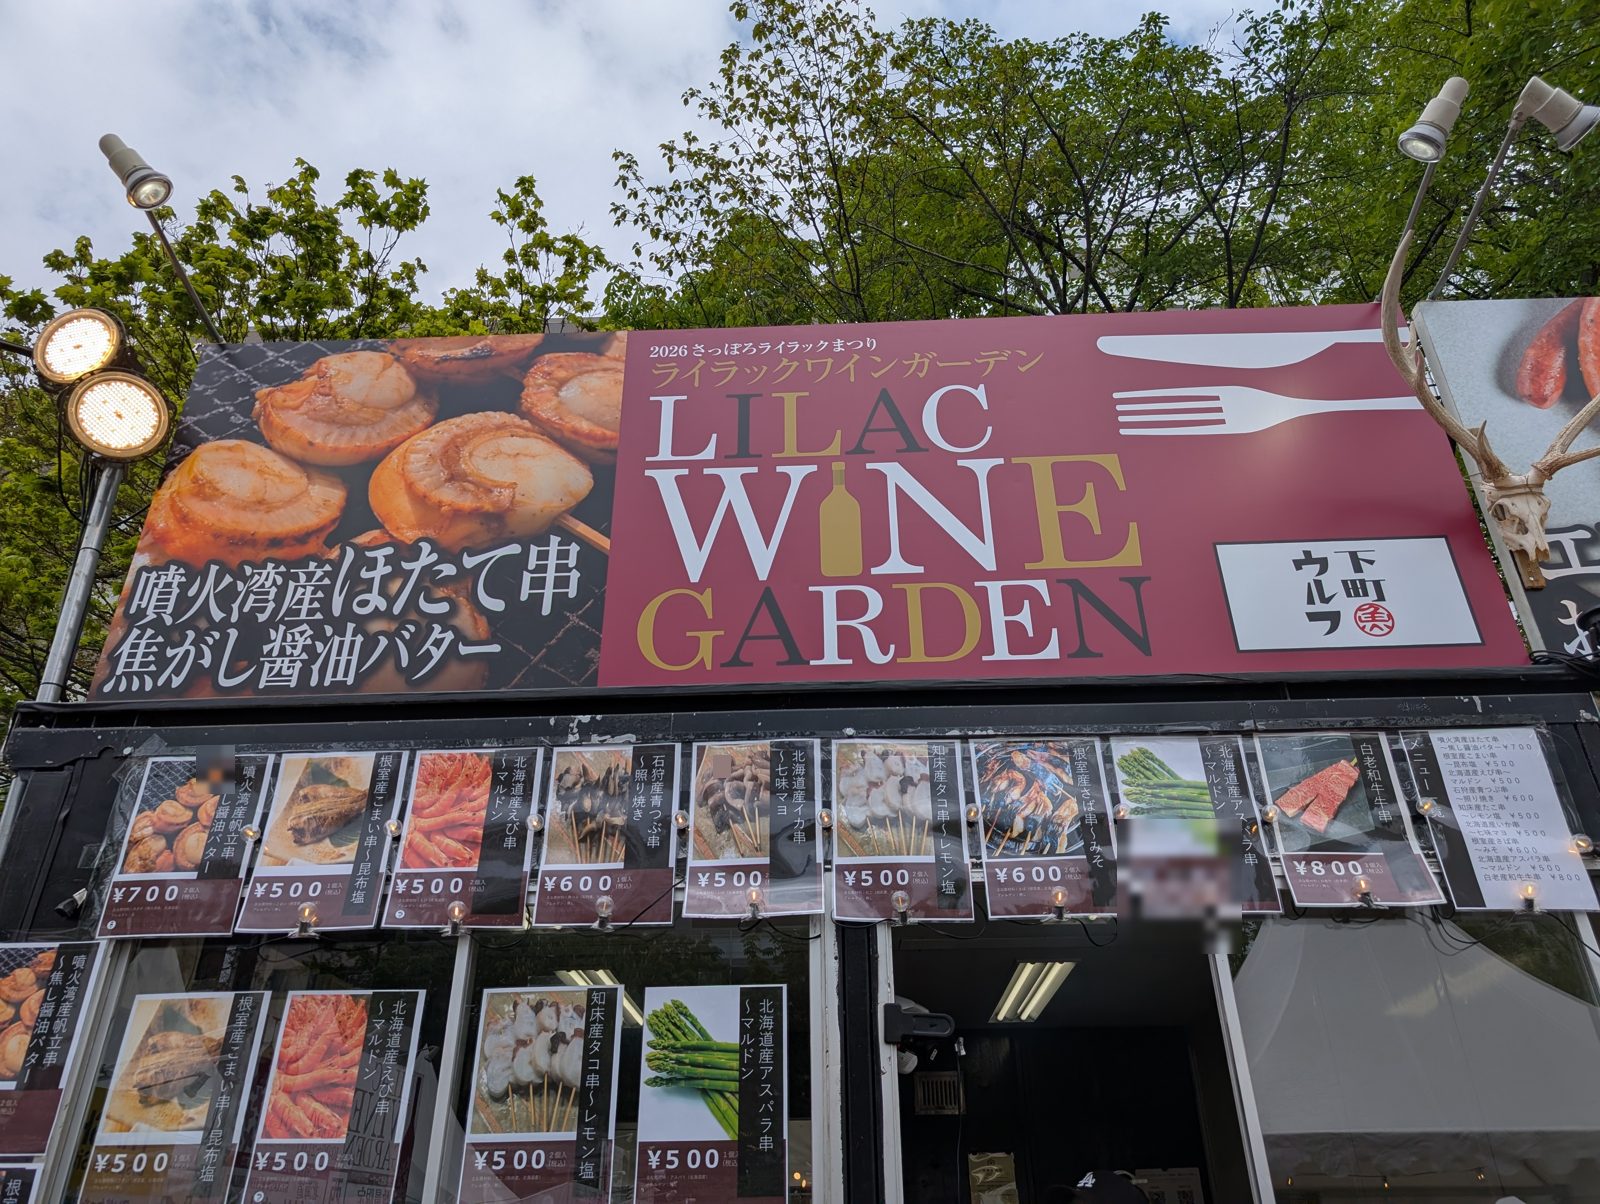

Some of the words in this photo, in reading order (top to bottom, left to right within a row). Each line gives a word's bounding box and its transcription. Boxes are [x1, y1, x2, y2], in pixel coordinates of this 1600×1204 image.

[649, 344, 688, 359] 2026
[691, 337, 878, 358] さっぽろライラックまつり
[651, 347, 1045, 388] ライラックワインガーデン
[645, 383, 993, 462] LILAC
[129, 534, 581, 627] 噴火湾産ほたて串
[1291, 549, 1343, 636] ウルフ
[1334, 549, 1387, 602] 下町
[102, 621, 503, 694] 焦がし醤油バター
[636, 576, 1153, 671] GARDEN
[221, 766, 256, 859] 噴火湾産帆立串
[490, 755, 509, 821] 〜マルドン
[503, 756, 527, 849] 北海道産えび串
[631, 755, 649, 821] 〜照り焼き
[646, 755, 667, 848] 石狩産青つぶ串
[775, 750, 789, 816] 〜七味マヨ
[791, 750, 807, 843] 北海道産イカ串
[1072, 747, 1104, 868] 根室産さば串〜みそ
[1204, 746, 1226, 811] 〜マルドン
[1360, 742, 1393, 823] 白老和牛牛串
[203, 792, 232, 873] し醤油バター
[350, 754, 393, 905] 根室産こまい串〜昆布塩
[931, 744, 956, 895] 知床産タコ串〜レモン塩
[112, 885, 179, 903] ¥700
[254, 881, 323, 898] ¥500
[395, 877, 463, 894] ¥500
[544, 875, 612, 892] ¥600
[697, 870, 762, 887] ¥500
[844, 869, 909, 886] ¥500
[995, 865, 1062, 883] ¥600
[1293, 860, 1362, 876] ¥800
[24, 955, 65, 1083] 〜焦し醤油バター
[42, 954, 87, 1066] 噴火湾産帆立串
[363, 1000, 386, 1080] 〜マルドン
[741, 999, 755, 1080] 〜マルドン
[200, 996, 253, 1182] 根室産こまい串〜昆布塩
[375, 1000, 407, 1115] 北海道産えび串
[579, 990, 606, 1180] 知床産タコ串〜レモン塩
[758, 998, 774, 1152] 北海道産アスパラ串
[94, 1152, 169, 1173] ¥500
[255, 1151, 329, 1171] ¥500
[475, 1150, 545, 1170] ¥500
[648, 1149, 719, 1169] ¥500
